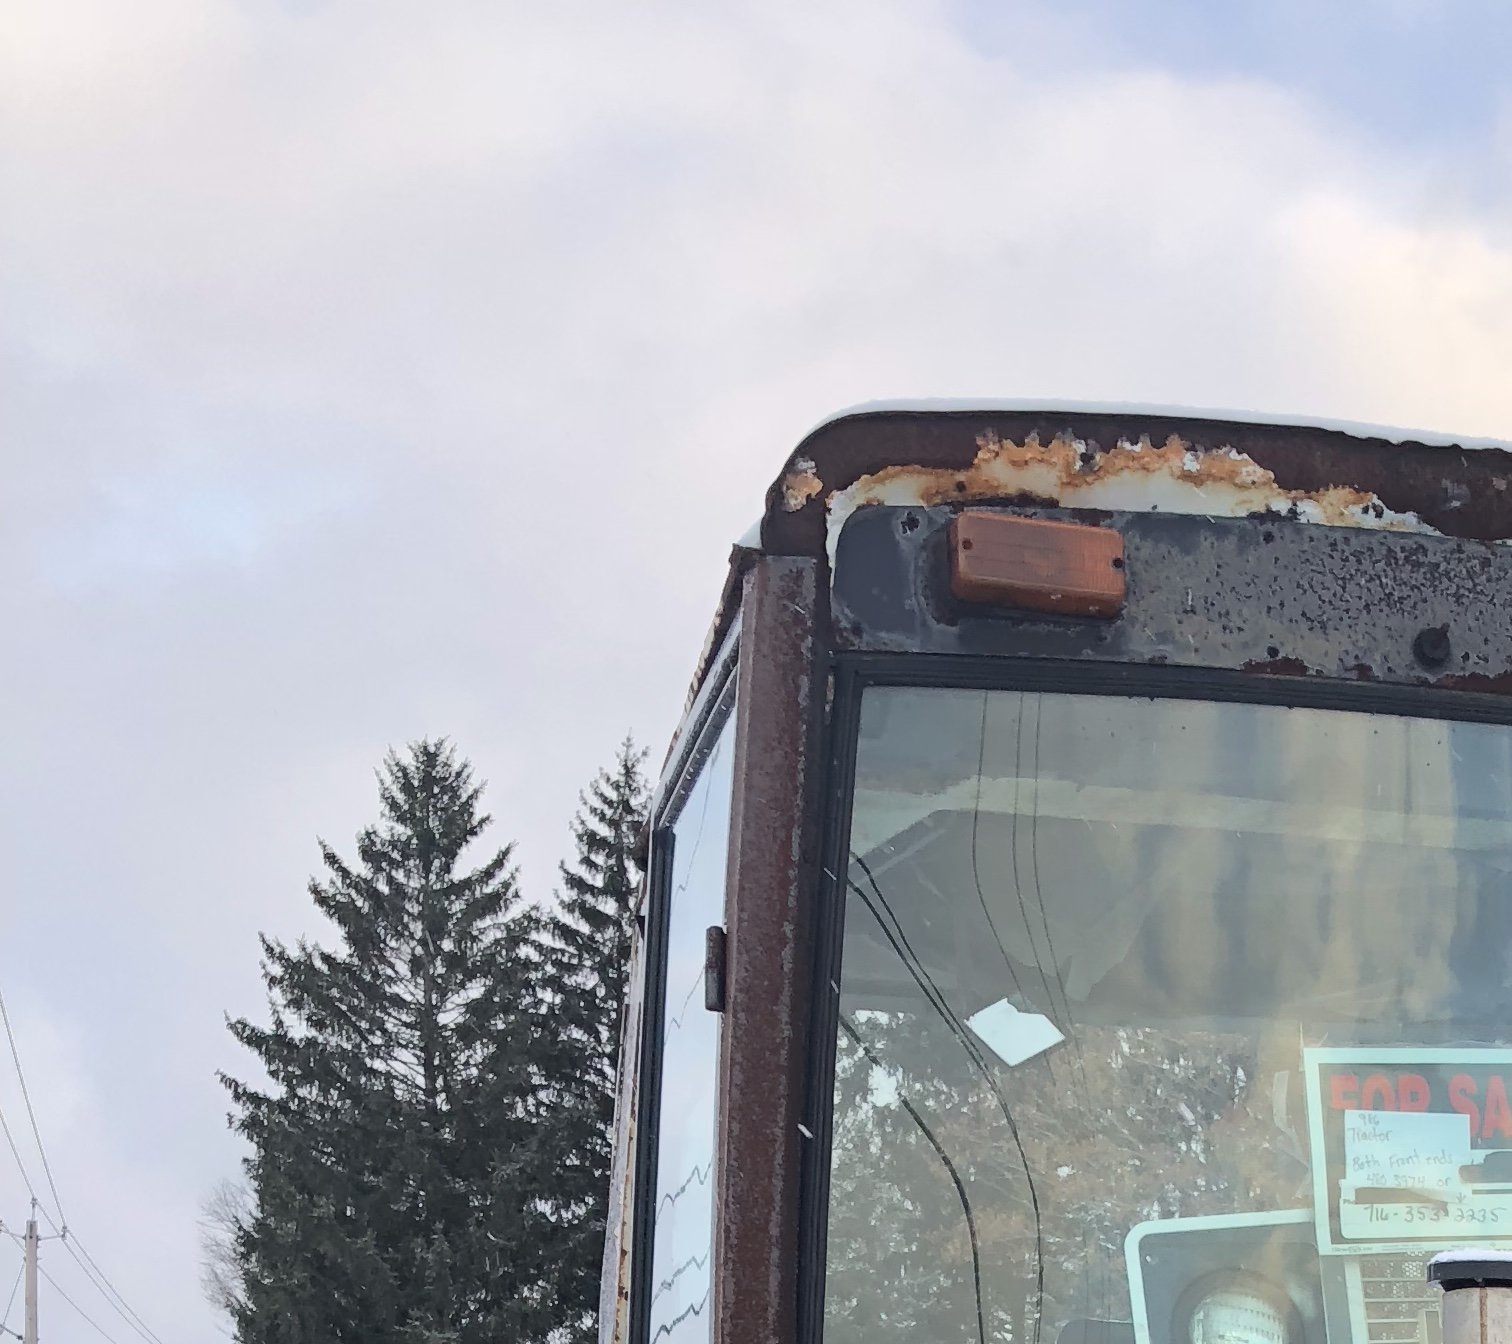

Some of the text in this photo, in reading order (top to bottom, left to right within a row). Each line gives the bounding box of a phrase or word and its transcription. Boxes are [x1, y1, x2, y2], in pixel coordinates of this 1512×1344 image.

[1347, 1127, 1392, 1142] Tractor
[1425, 1149, 1454, 1165] ends
[1437, 1177, 1452, 1187] or
